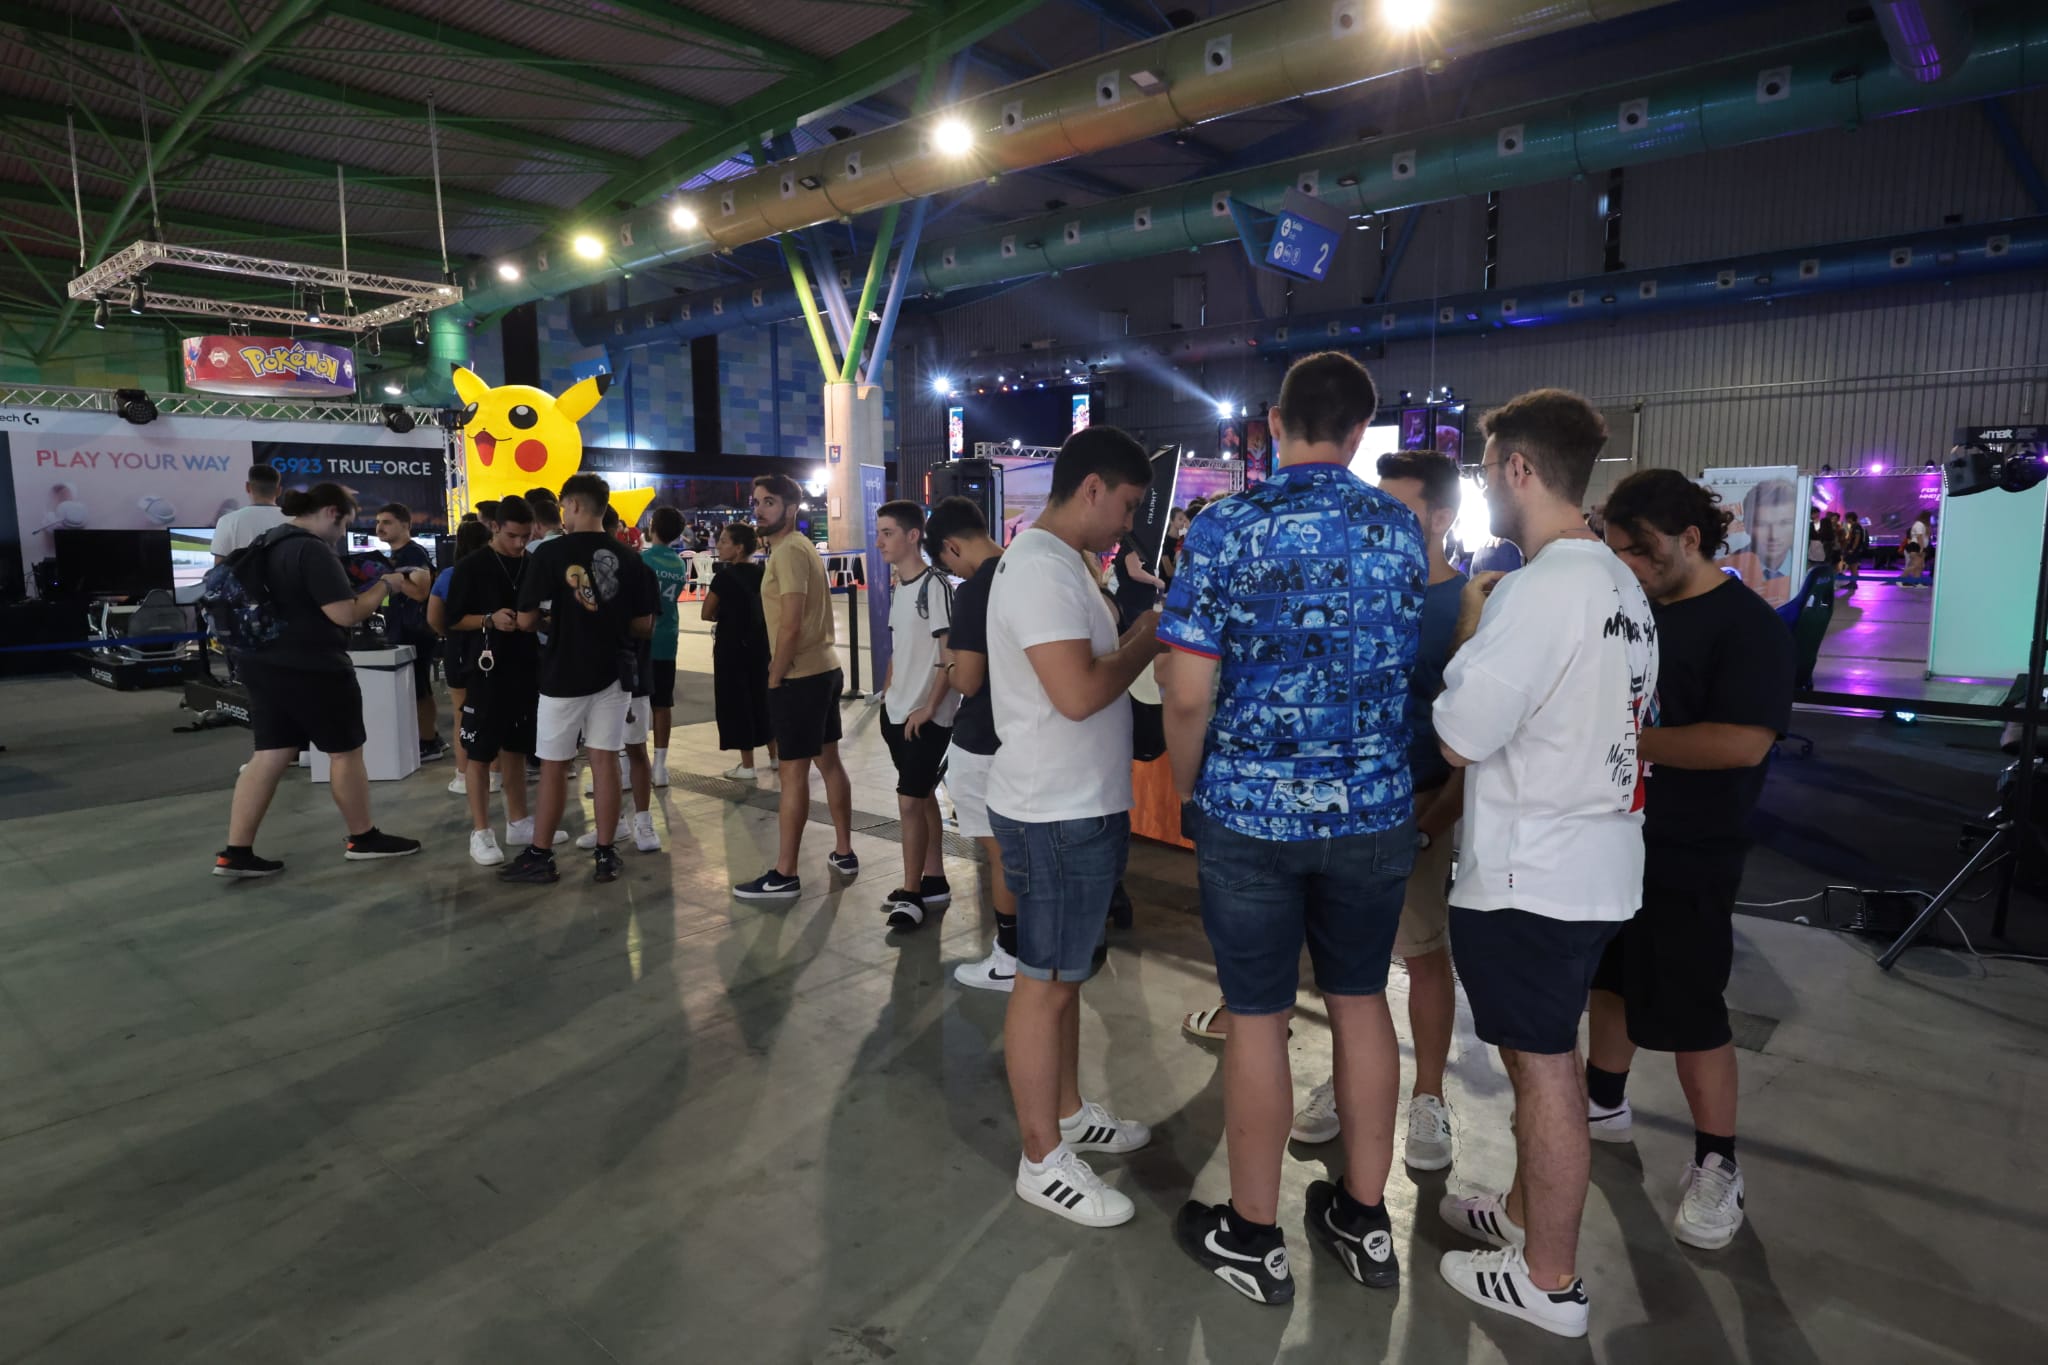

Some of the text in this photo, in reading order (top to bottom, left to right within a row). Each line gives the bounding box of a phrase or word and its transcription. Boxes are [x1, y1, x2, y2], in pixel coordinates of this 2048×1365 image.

[1313, 243, 1329, 274] 2
[36, 450, 231, 472] PLAY YOUR WAY
[271, 457, 432, 476] G923 TRUEFORCE
